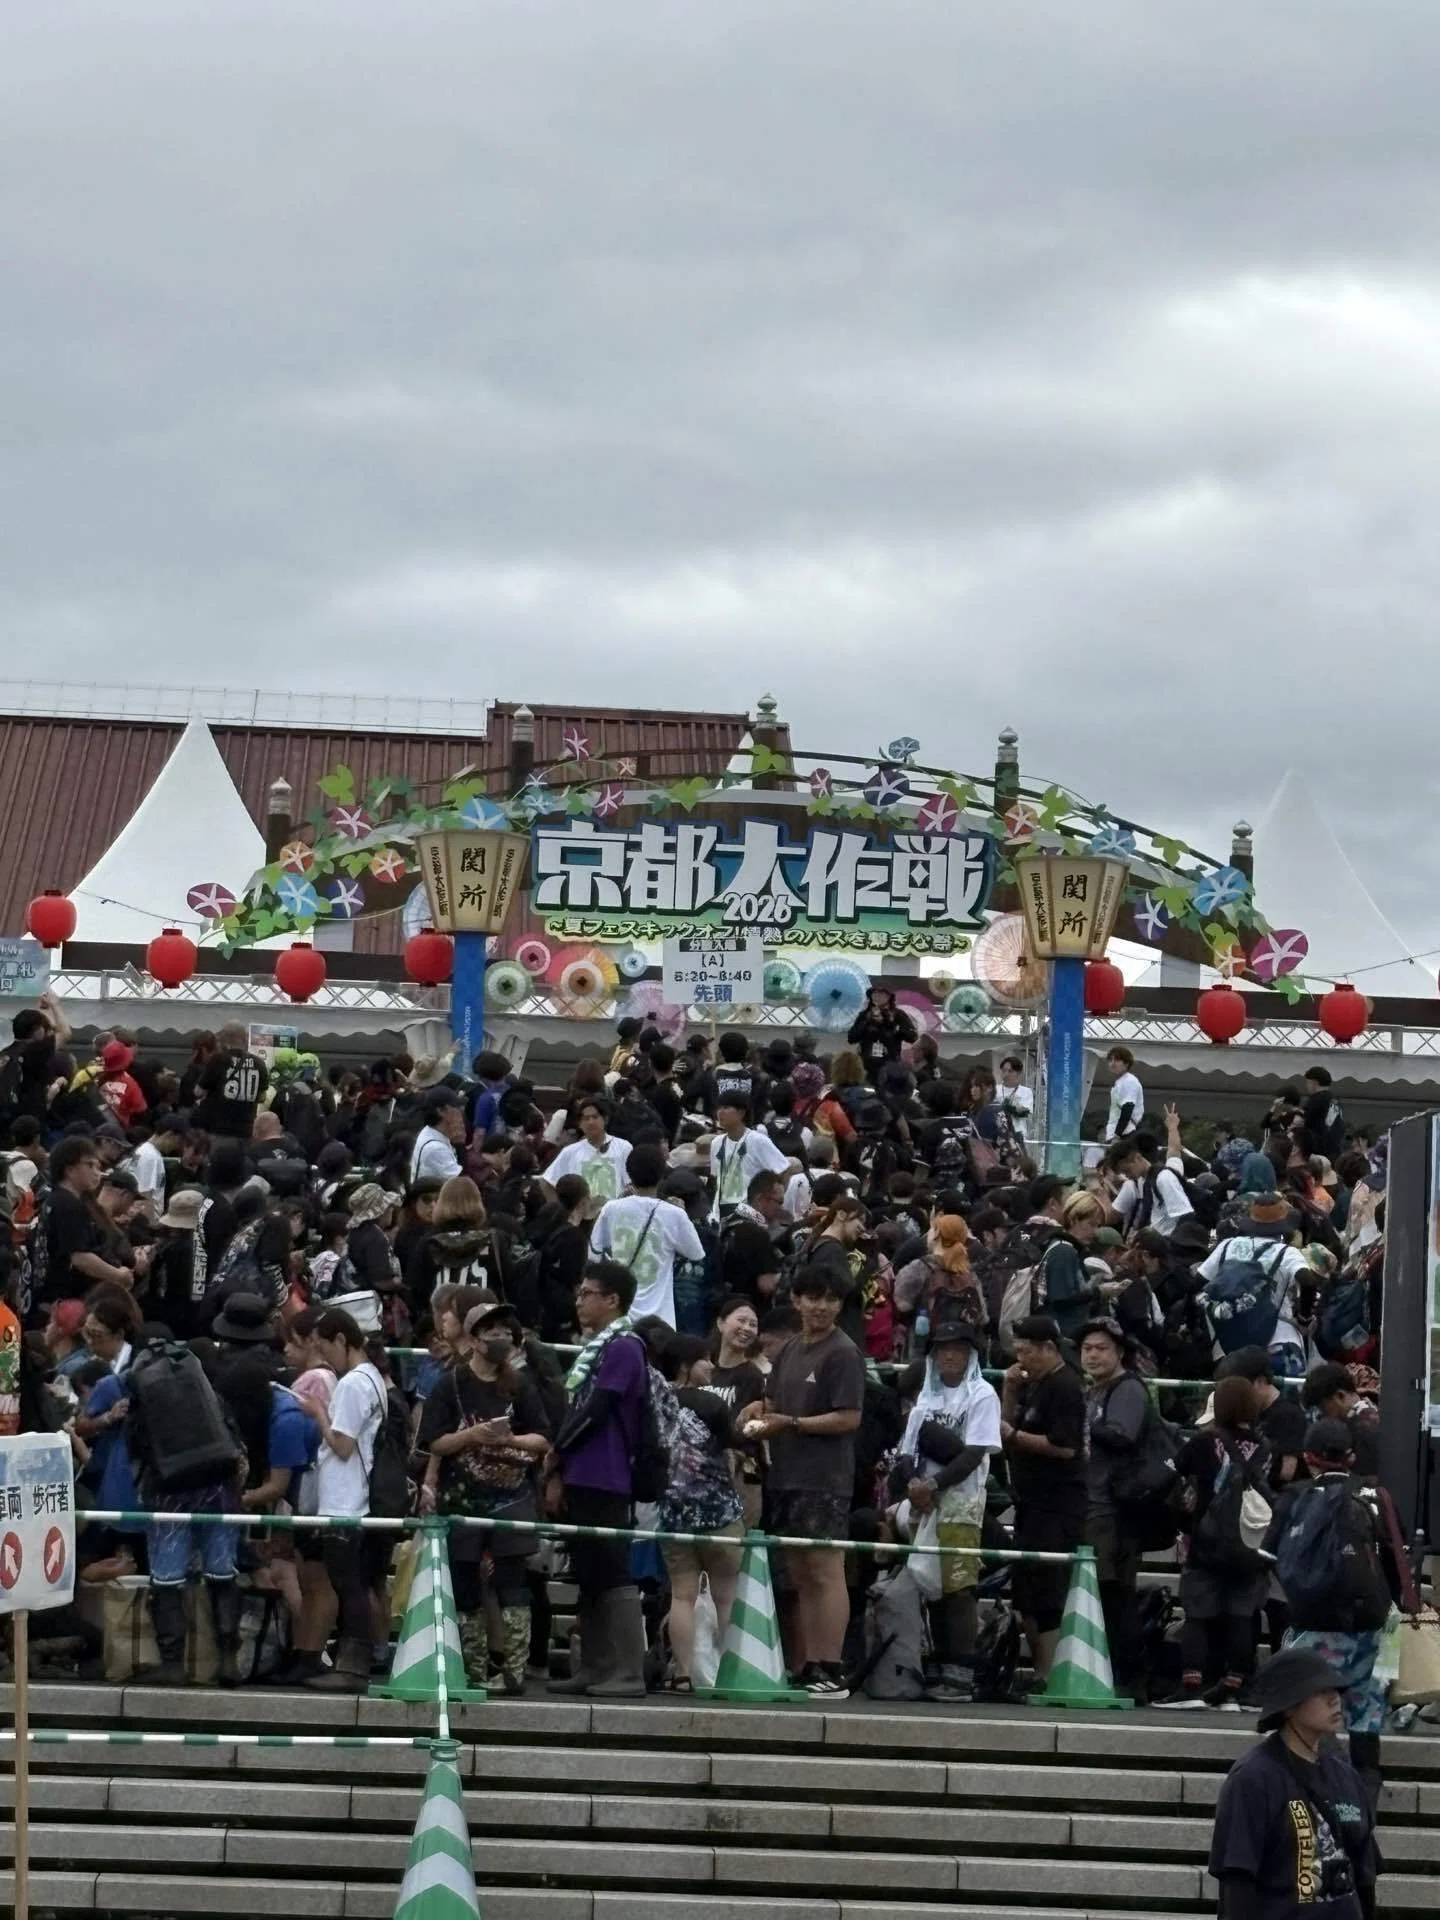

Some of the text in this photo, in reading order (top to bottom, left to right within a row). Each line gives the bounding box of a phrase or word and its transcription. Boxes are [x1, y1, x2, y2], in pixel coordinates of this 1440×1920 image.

[459, 847, 487, 911] 関所
[537, 819, 984, 923] 京都大作戦
[723, 893, 792, 923] 2026
[1059, 875, 1088, 937] 関所
[694, 985, 732, 1002] 先頭
[32, 1482, 68, 1515] 歩行者
